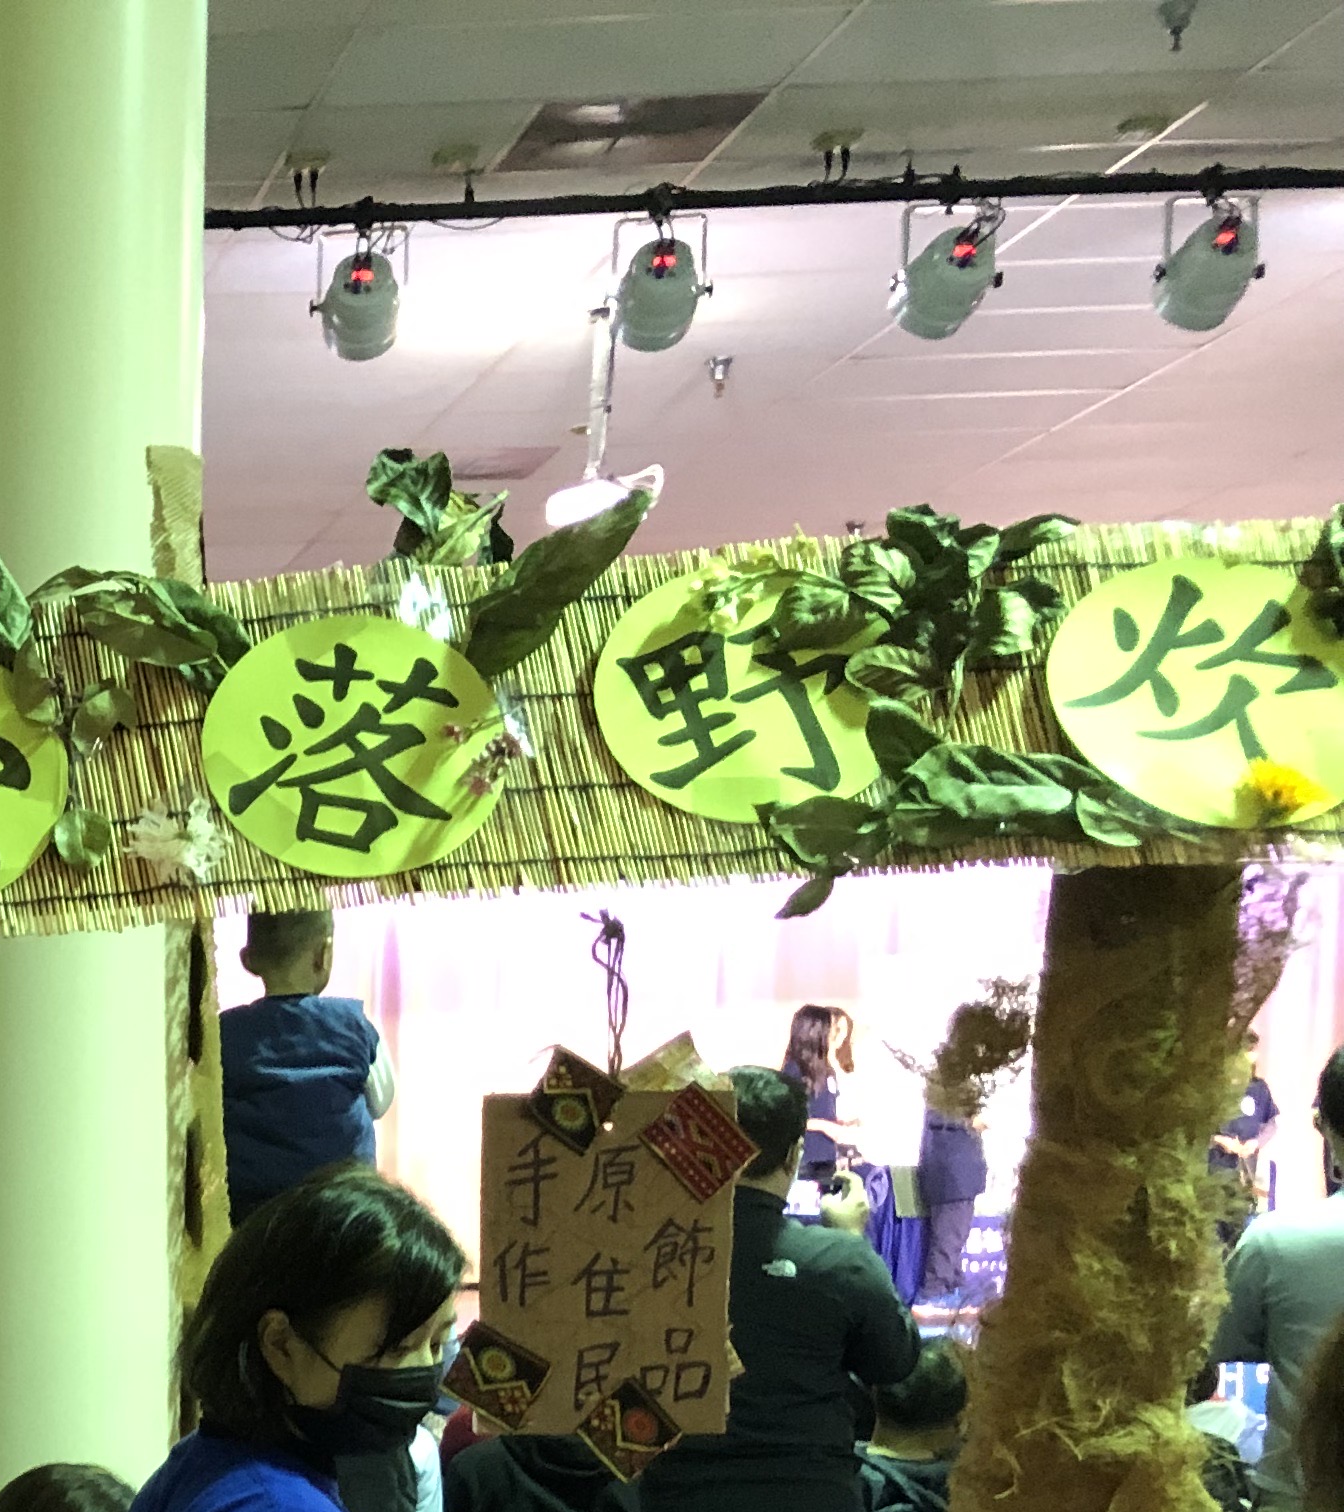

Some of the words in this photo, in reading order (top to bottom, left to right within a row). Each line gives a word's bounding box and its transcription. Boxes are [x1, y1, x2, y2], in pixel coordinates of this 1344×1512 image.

[493, 1134, 560, 1308] 手作
[572, 1144, 641, 1412] 原住民
[640, 1218, 717, 1402] 飾品
